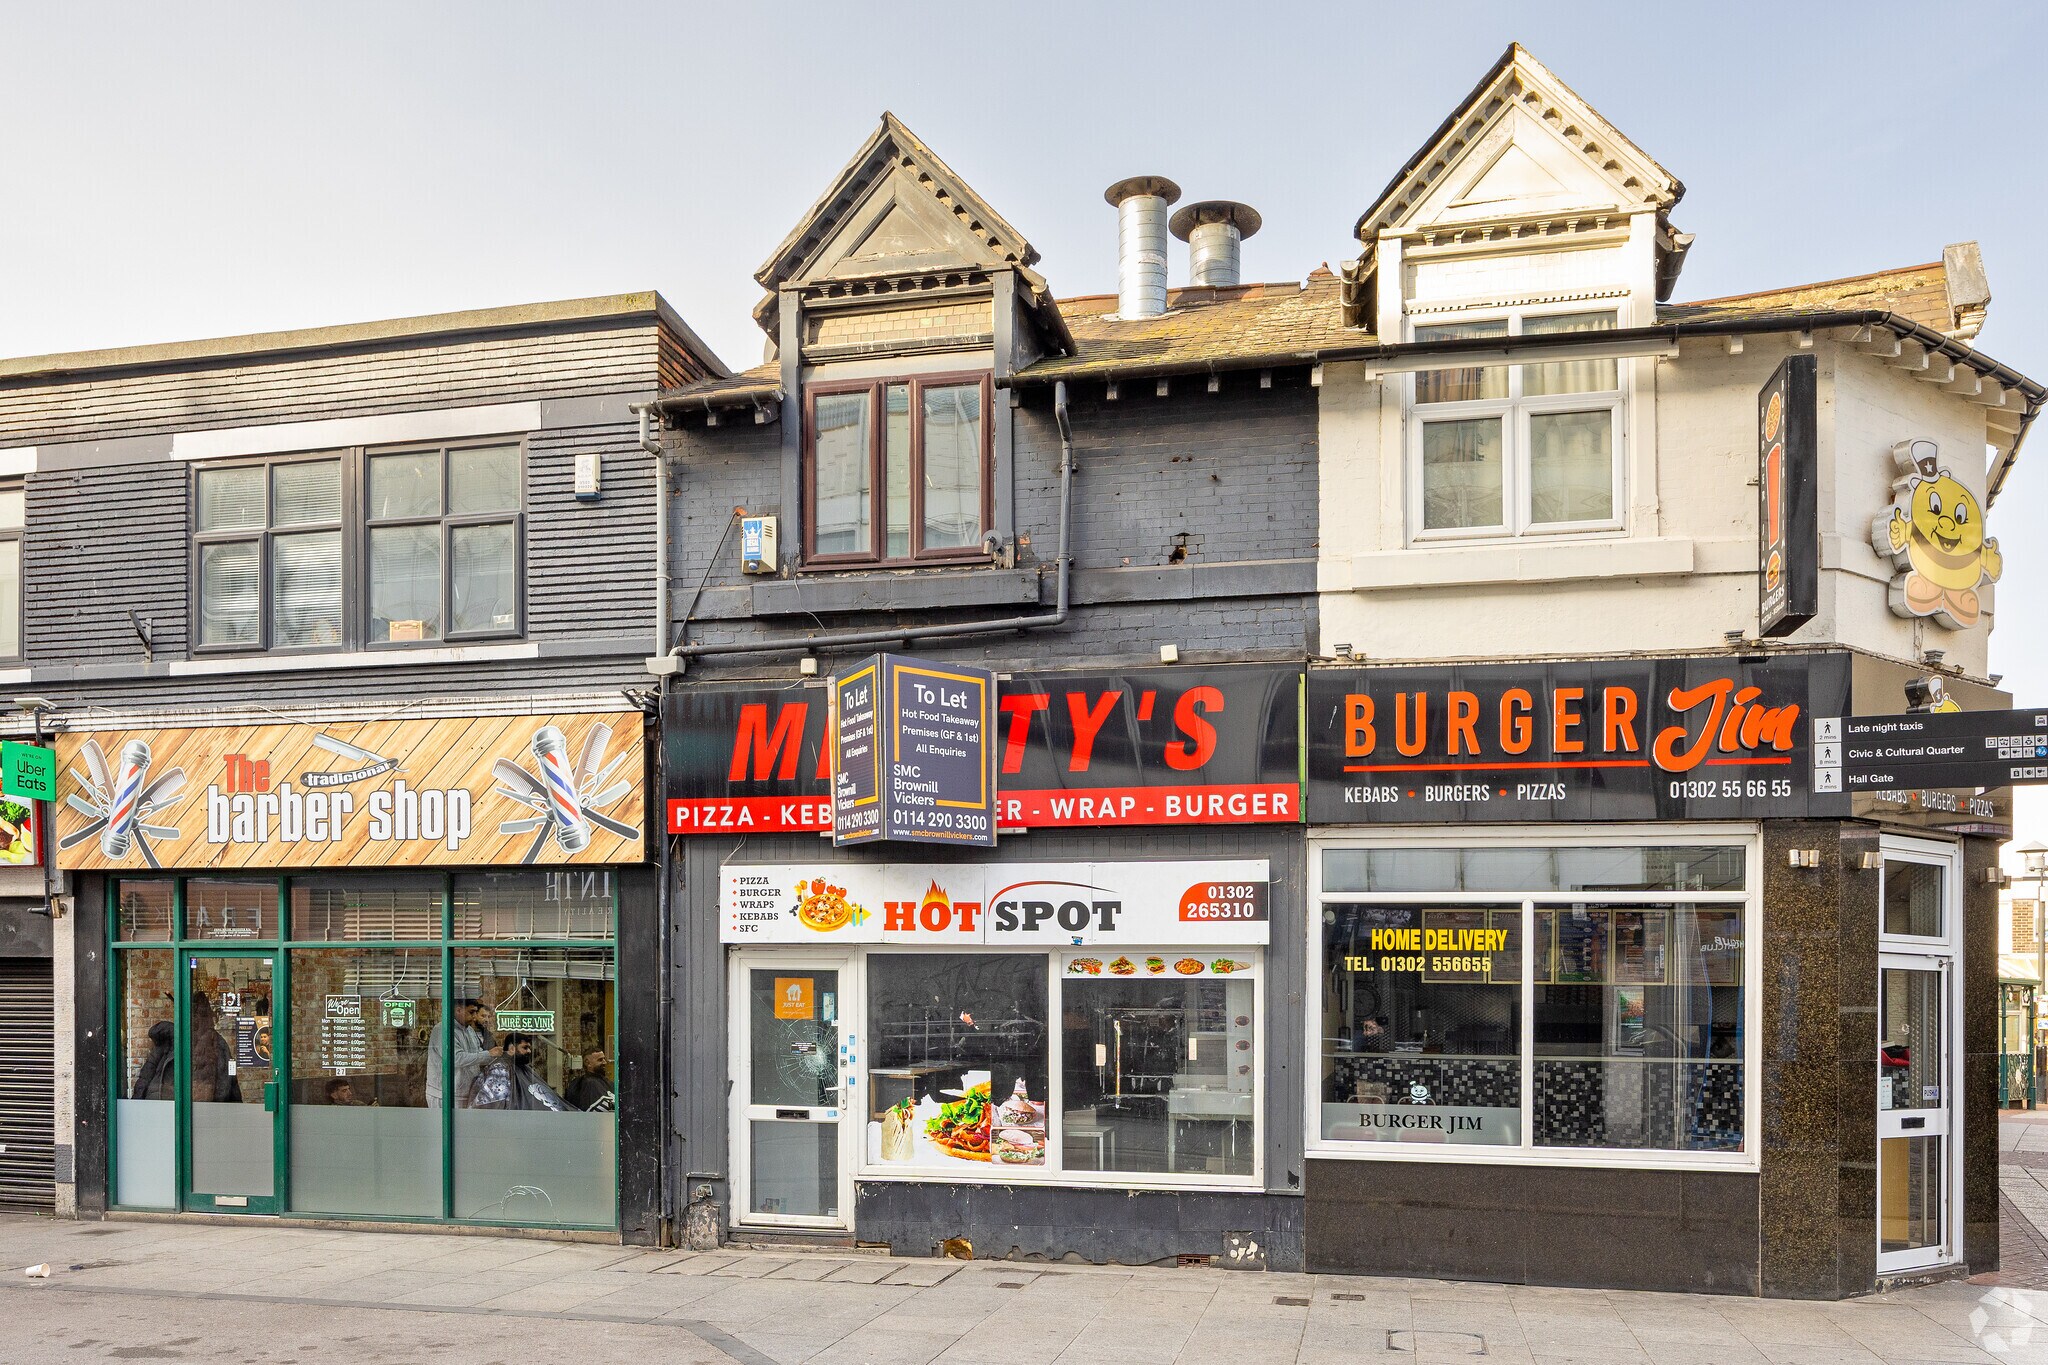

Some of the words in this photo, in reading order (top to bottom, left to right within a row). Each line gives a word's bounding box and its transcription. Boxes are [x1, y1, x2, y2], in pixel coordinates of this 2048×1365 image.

[1762, 584, 1785, 614] BURGERS
[845, 692, 854, 710] To
[855, 685, 868, 707] Let
[913, 684, 935, 704] To
[940, 687, 968, 710] Let
[902, 708, 918, 719] Hot
[919, 710, 940, 722] Food
[941, 713, 979, 729] Takeaway
[1344, 686, 1641, 759] BURGER
[1652, 678, 1800, 773] Jim
[902, 725, 939, 738] Premises
[940, 728, 956, 741] (GF
[956, 731, 963, 741] &
[964, 731, 979, 744] 1st)
[1848, 724, 1870, 733] Late
[1872, 722, 1897, 734] night
[1899, 721, 1924, 731] taxis
[916, 744, 928, 753] All
[929, 745, 967, 758] Enquiries
[1848, 748, 1874, 758] Civic
[1875, 748, 1884, 757] &
[1885, 747, 1924, 757] Cultural
[1926, 745, 1965, 755] Quarter
[17, 760, 46, 777] Uber
[223, 754, 270, 793] The
[893, 764, 921, 778] SMC
[17, 775, 47, 791] Eats
[837, 772, 849, 785] SMC
[894, 778, 938, 793] Brownill
[1848, 774, 1867, 784] Hall
[1869, 773, 1894, 783] Gate
[1344, 786, 1399, 804] KEBABS
[1424, 784, 1490, 803] BURGERS
[1516, 783, 1566, 801] PIZZAS
[1669, 781, 1717, 799] 01302
[1721, 781, 1741, 798] 55
[1746, 780, 1767, 798] 66
[1771, 779, 1792, 798] 55
[837, 799, 855, 811] Vickers
[893, 791, 935, 807] Vickers
[1050, 796, 1136, 820] WRAP
[1165, 793, 1289, 817] BURGER
[1921, 790, 1956, 812] BURGERS
[1969, 798, 1994, 818] PIZZAS
[207, 781, 354, 844] barber
[368, 779, 472, 851] shop
[676, 805, 754, 827] PIZZA
[781, 804, 833, 826] KEB
[837, 815, 851, 831] 0114
[851, 812, 863, 829] 290
[863, 809, 879, 826] 3300
[893, 809, 925, 827] 0114
[928, 812, 953, 829] 290
[956, 814, 987, 831] 3300
[893, 827, 988, 841] www.smcbrownillvickers.com
[739, 877, 770, 885] PIZZA
[739, 889, 781, 897] BURGER
[1207, 885, 1254, 900] 01302
[739, 901, 775, 909] WRAPS
[1187, 901, 1255, 919] 265310
[739, 913, 779, 921] KEBABS
[883, 901, 981, 932] HOT
[995, 900, 1121, 932] SPOT
[1371, 928, 1422, 950] HOME
[1425, 929, 1508, 951] DELIVERY
[1345, 956, 1375, 972] TEL.
[1381, 956, 1426, 972] 01302
[1432, 957, 1492, 972] 556655
[336, 1005, 360, 1017] Open
[501, 1016, 521, 1028] MIRË
[522, 1018, 533, 1028] SE
[533, 1017, 551, 1028] VINI
[1359, 1113, 1444, 1130] BURGER
[1446, 1115, 1483, 1135] JIM
